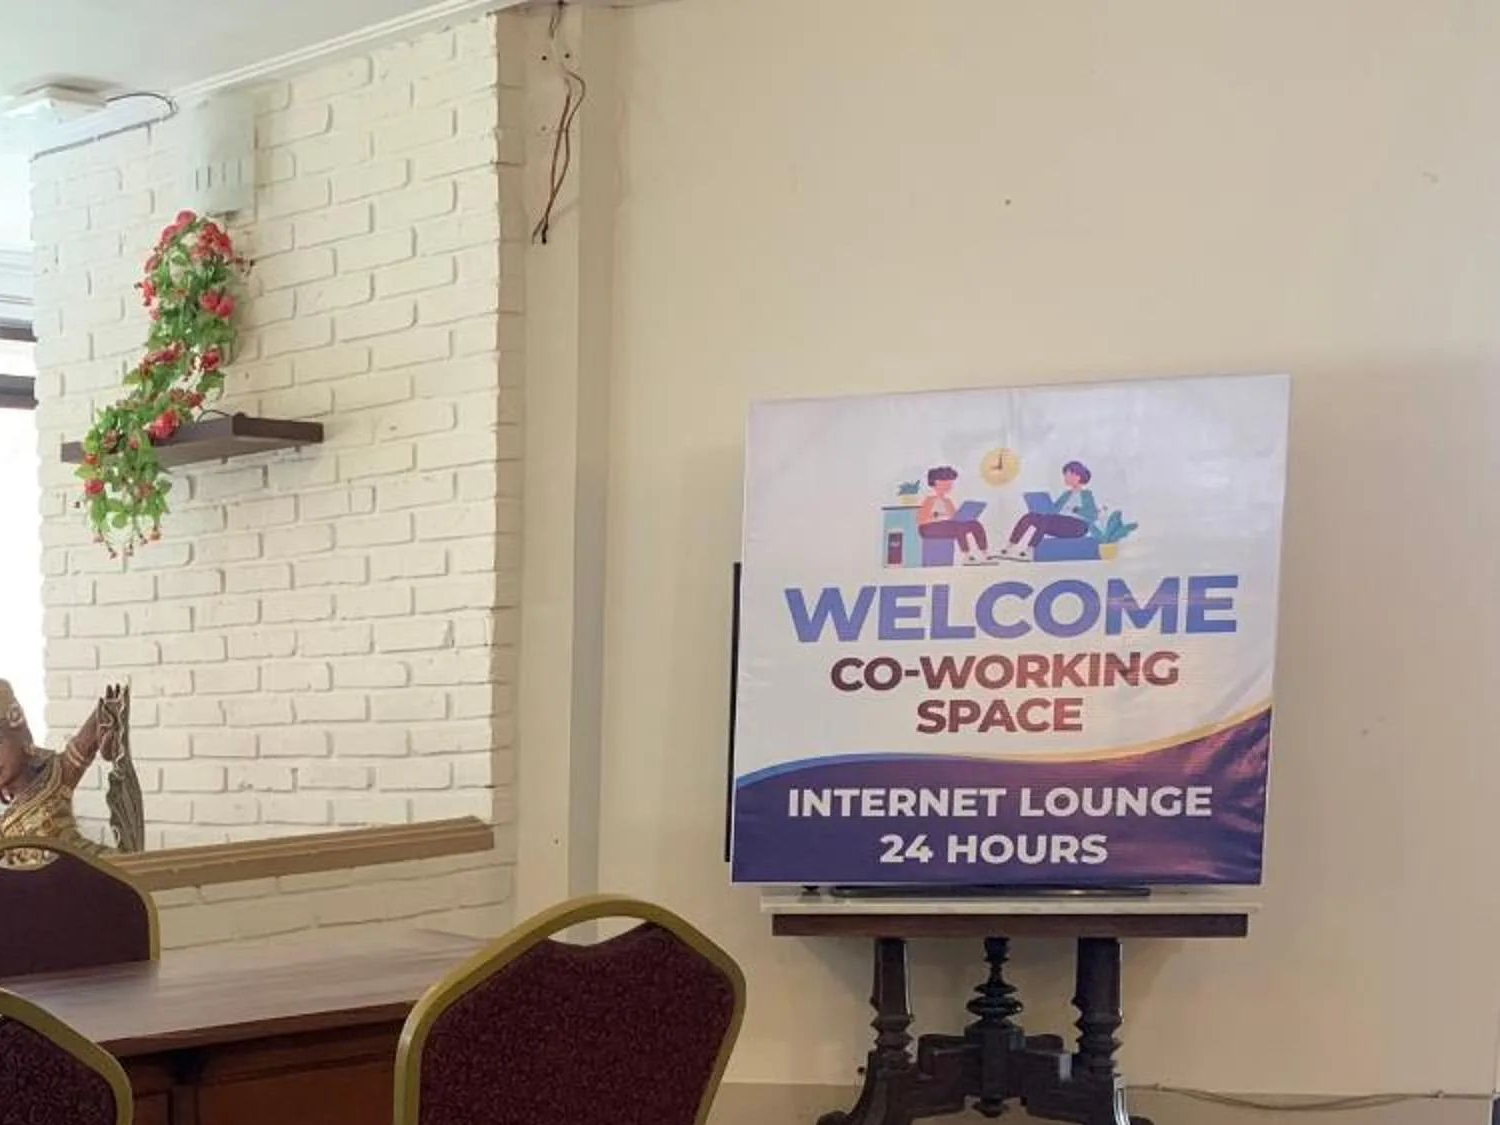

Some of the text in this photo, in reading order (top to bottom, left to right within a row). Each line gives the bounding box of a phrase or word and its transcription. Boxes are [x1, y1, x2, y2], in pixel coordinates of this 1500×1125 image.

[785, 575, 1238, 642] WELCOME
[831, 651, 1179, 692] CO-WORKING
[917, 697, 1084, 734] SPACE
[788, 785, 1212, 818] INTERNET LOUNGE
[879, 833, 1108, 865] 24 HOURS
